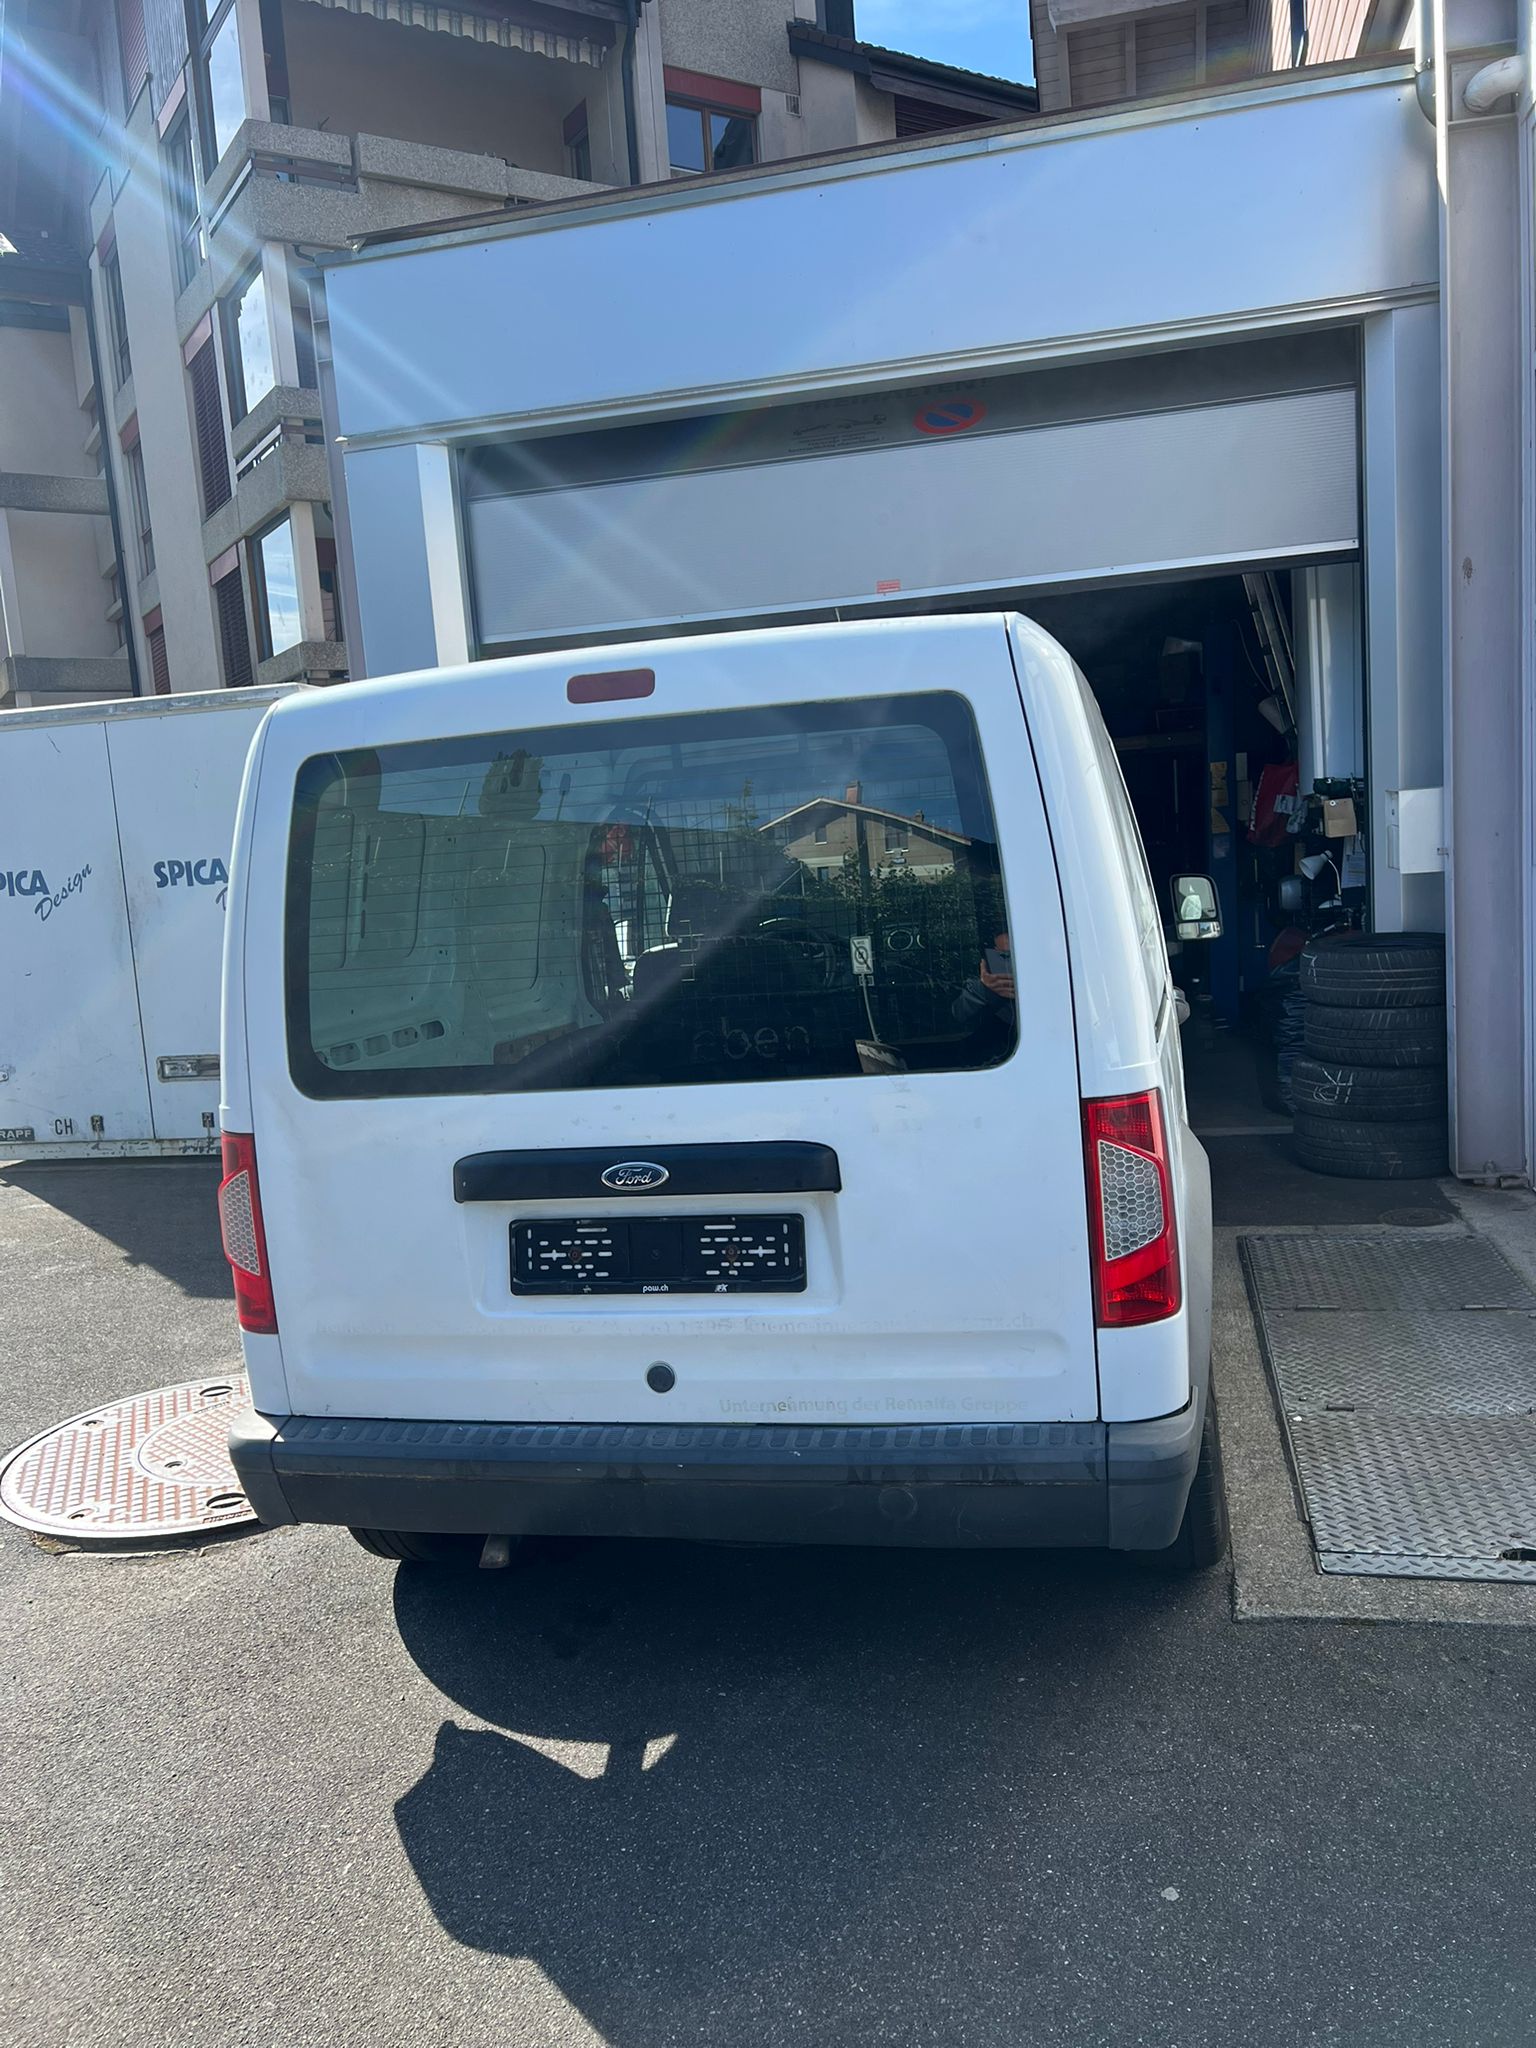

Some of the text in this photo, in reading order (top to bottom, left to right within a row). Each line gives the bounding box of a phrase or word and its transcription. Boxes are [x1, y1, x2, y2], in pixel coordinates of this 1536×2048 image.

[154, 857, 229, 888] SPICA
[34, 863, 93, 922] Design
[54, 1117, 74, 1136] CH
[615, 1167, 652, 1187] Ford
